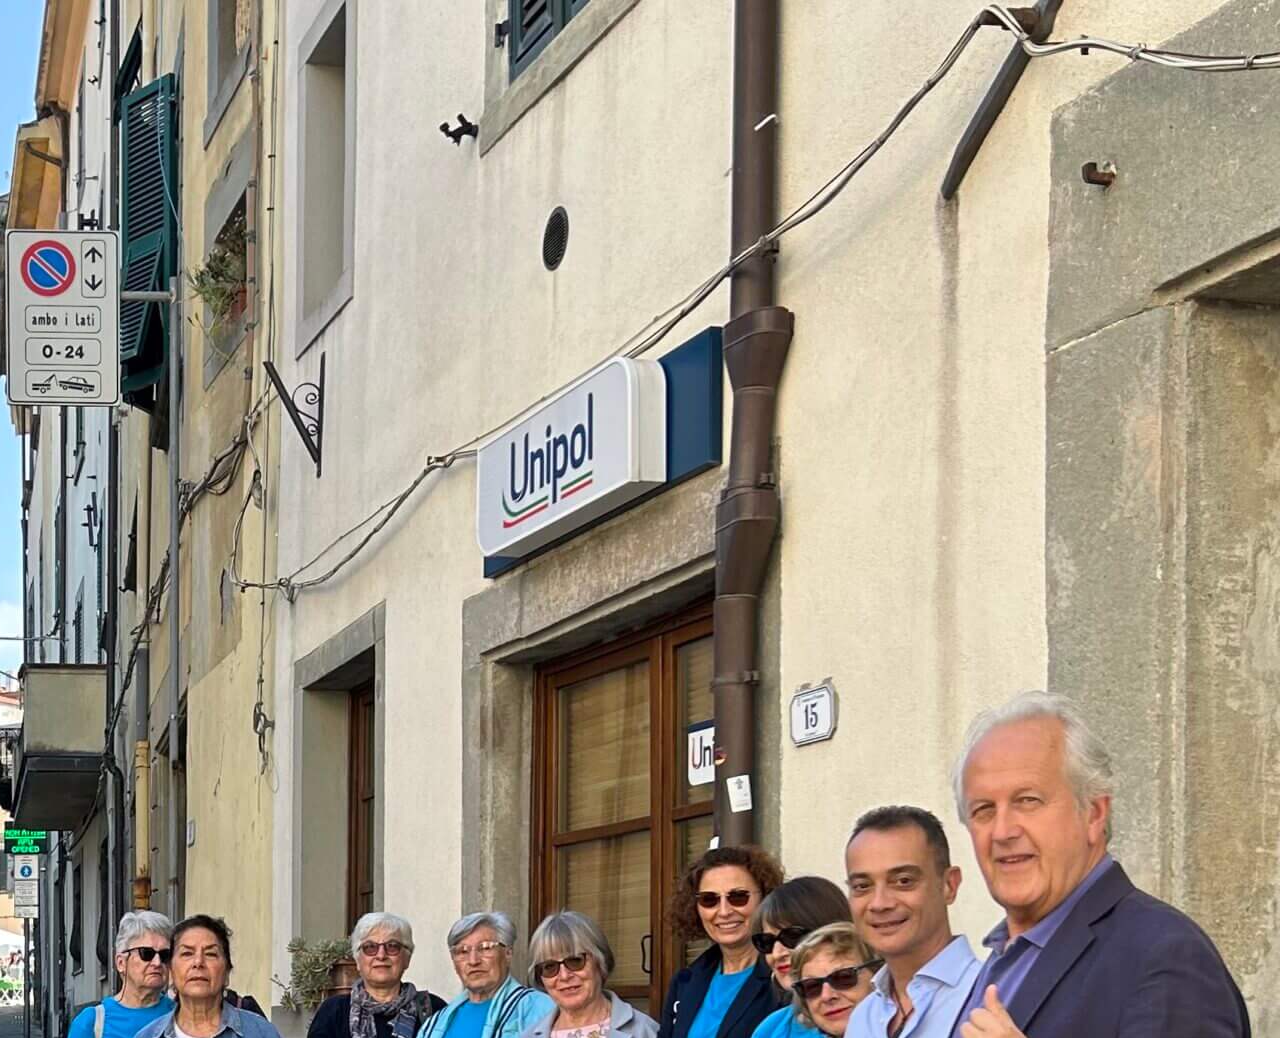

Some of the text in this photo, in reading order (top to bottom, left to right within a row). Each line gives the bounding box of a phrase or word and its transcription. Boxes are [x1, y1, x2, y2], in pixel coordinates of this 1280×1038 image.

[31, 312, 58, 326] ambo
[75, 312, 95, 326] lati
[509, 392, 594, 504] Unipol
[804, 702, 818, 730] 15
[692, 735, 715, 770] Un
